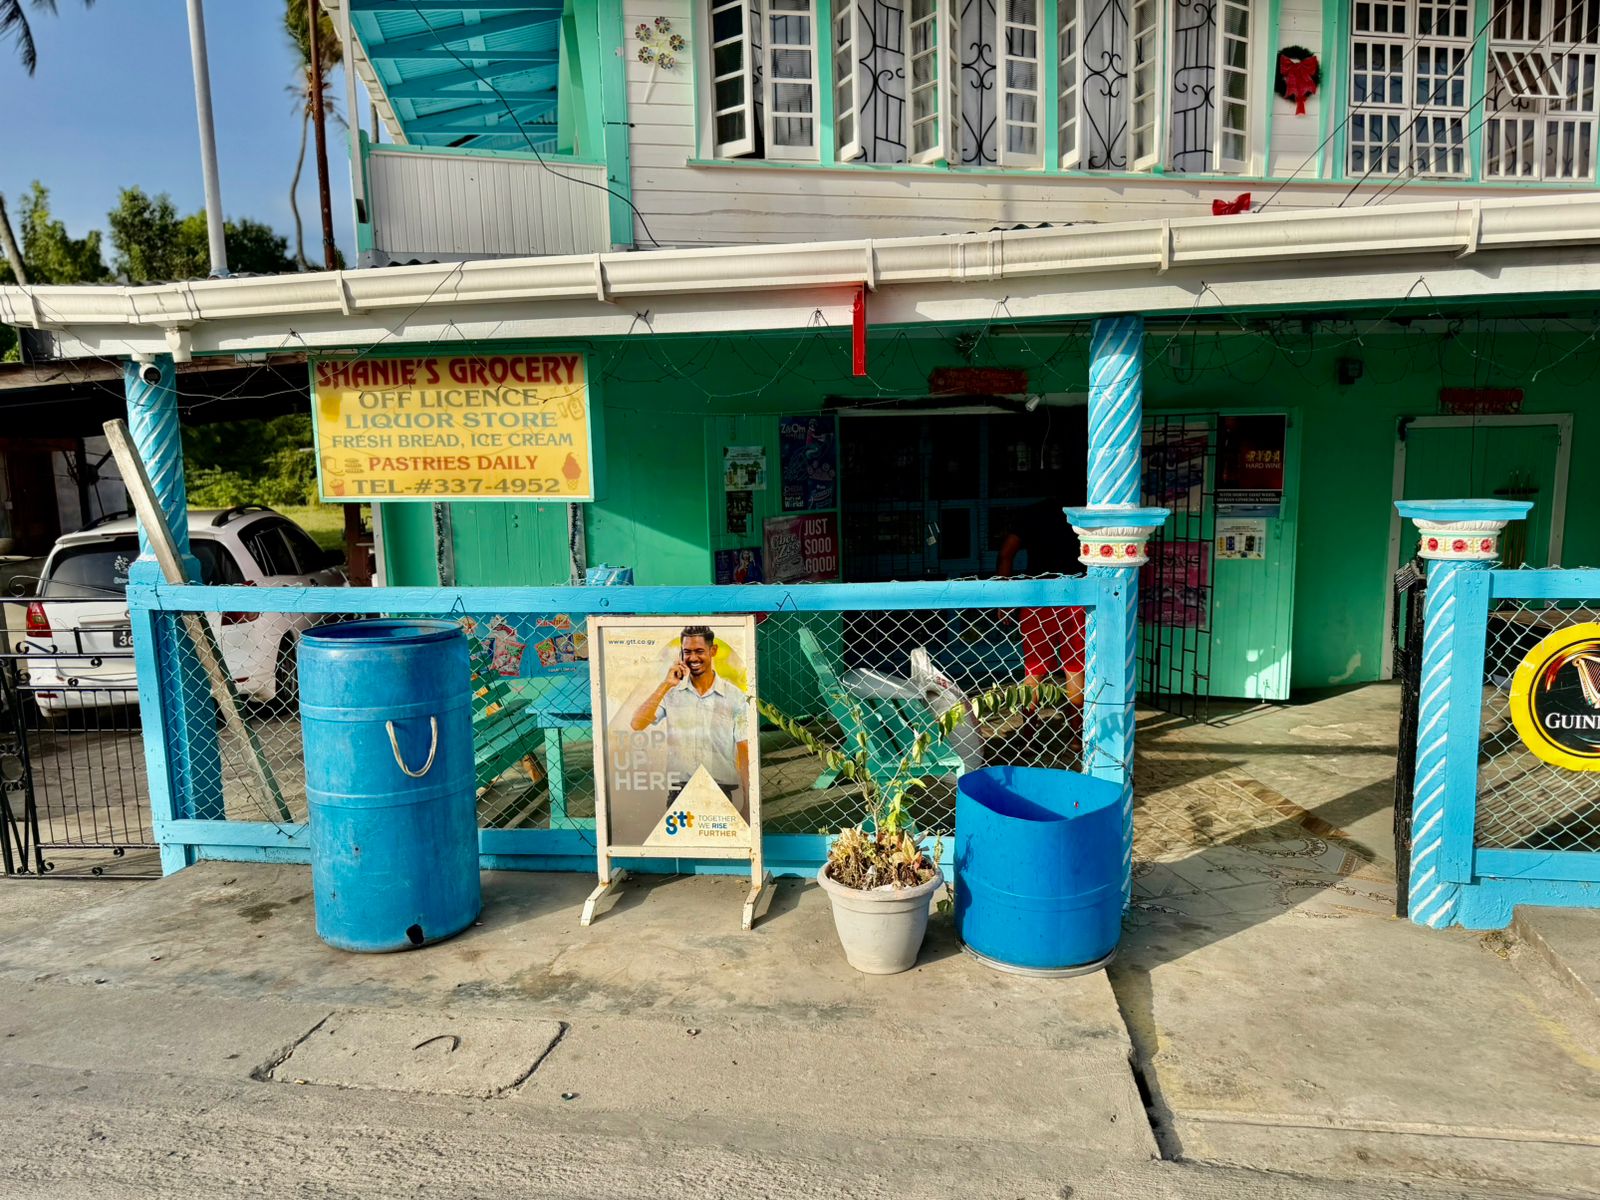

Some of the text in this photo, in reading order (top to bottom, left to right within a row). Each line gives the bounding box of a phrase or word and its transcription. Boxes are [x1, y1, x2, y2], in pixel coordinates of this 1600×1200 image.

[316, 355, 579, 389] SHANIE'S GROCERY
[359, 388, 540, 410] OFF LICENCE
[345, 411, 558, 430] LIQUOR STORE
[332, 432, 573, 448] FRESH BREAD, ICE CREAM
[368, 455, 538, 472] PASTRIES DAILY
[804, 518, 828, 536] JUST
[804, 537, 832, 556] SOOO
[805, 556, 836, 574] GOOD!
[1545, 712, 1600, 729] GUIN
[613, 730, 667, 751] TOP
[613, 751, 647, 770] UP
[615, 771, 682, 791] HERE
[665, 810, 695, 836] gtt
[698, 814, 737, 822] TOGETHER
